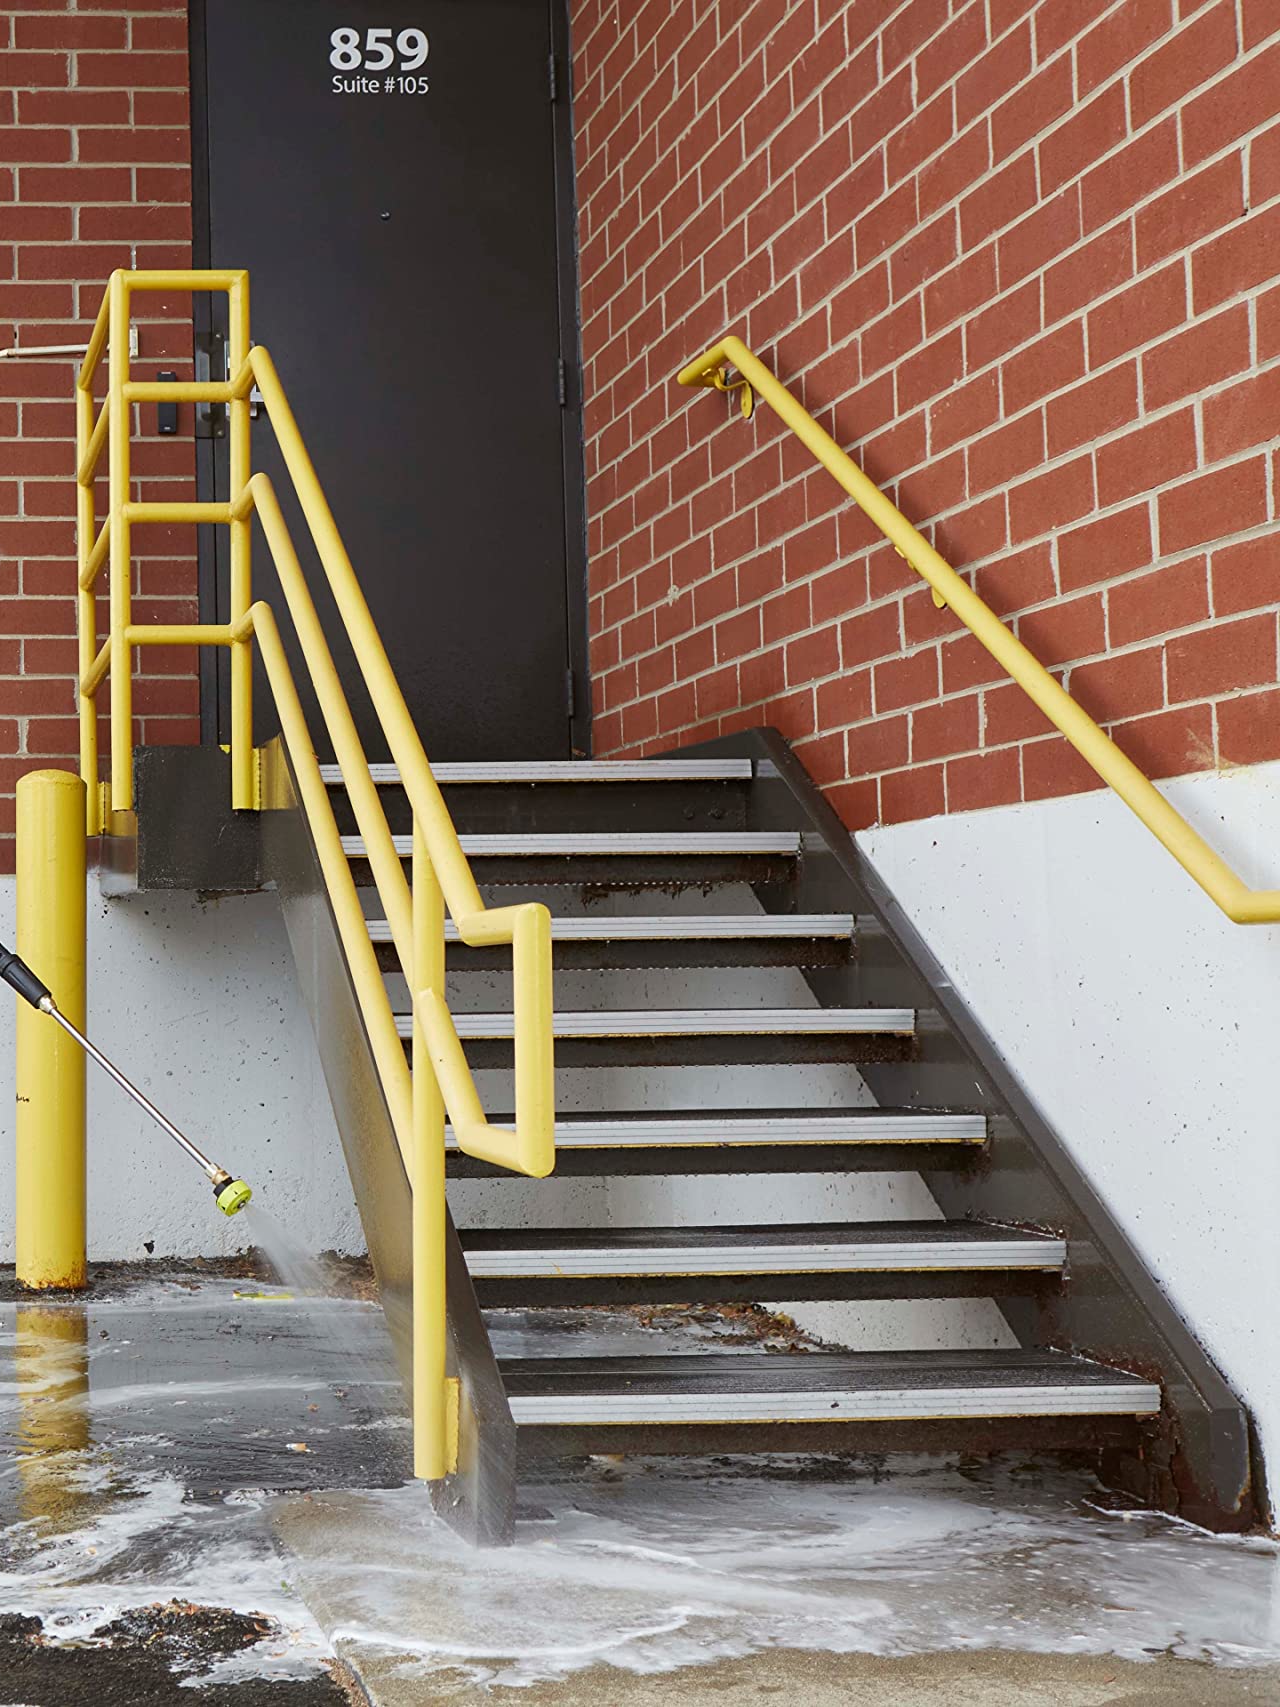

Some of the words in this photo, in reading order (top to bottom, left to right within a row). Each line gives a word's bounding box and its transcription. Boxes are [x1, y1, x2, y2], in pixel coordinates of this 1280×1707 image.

[329, 27, 429, 71] 859
[332, 75, 380, 94] Suite
[384, 76, 429, 94] #105
